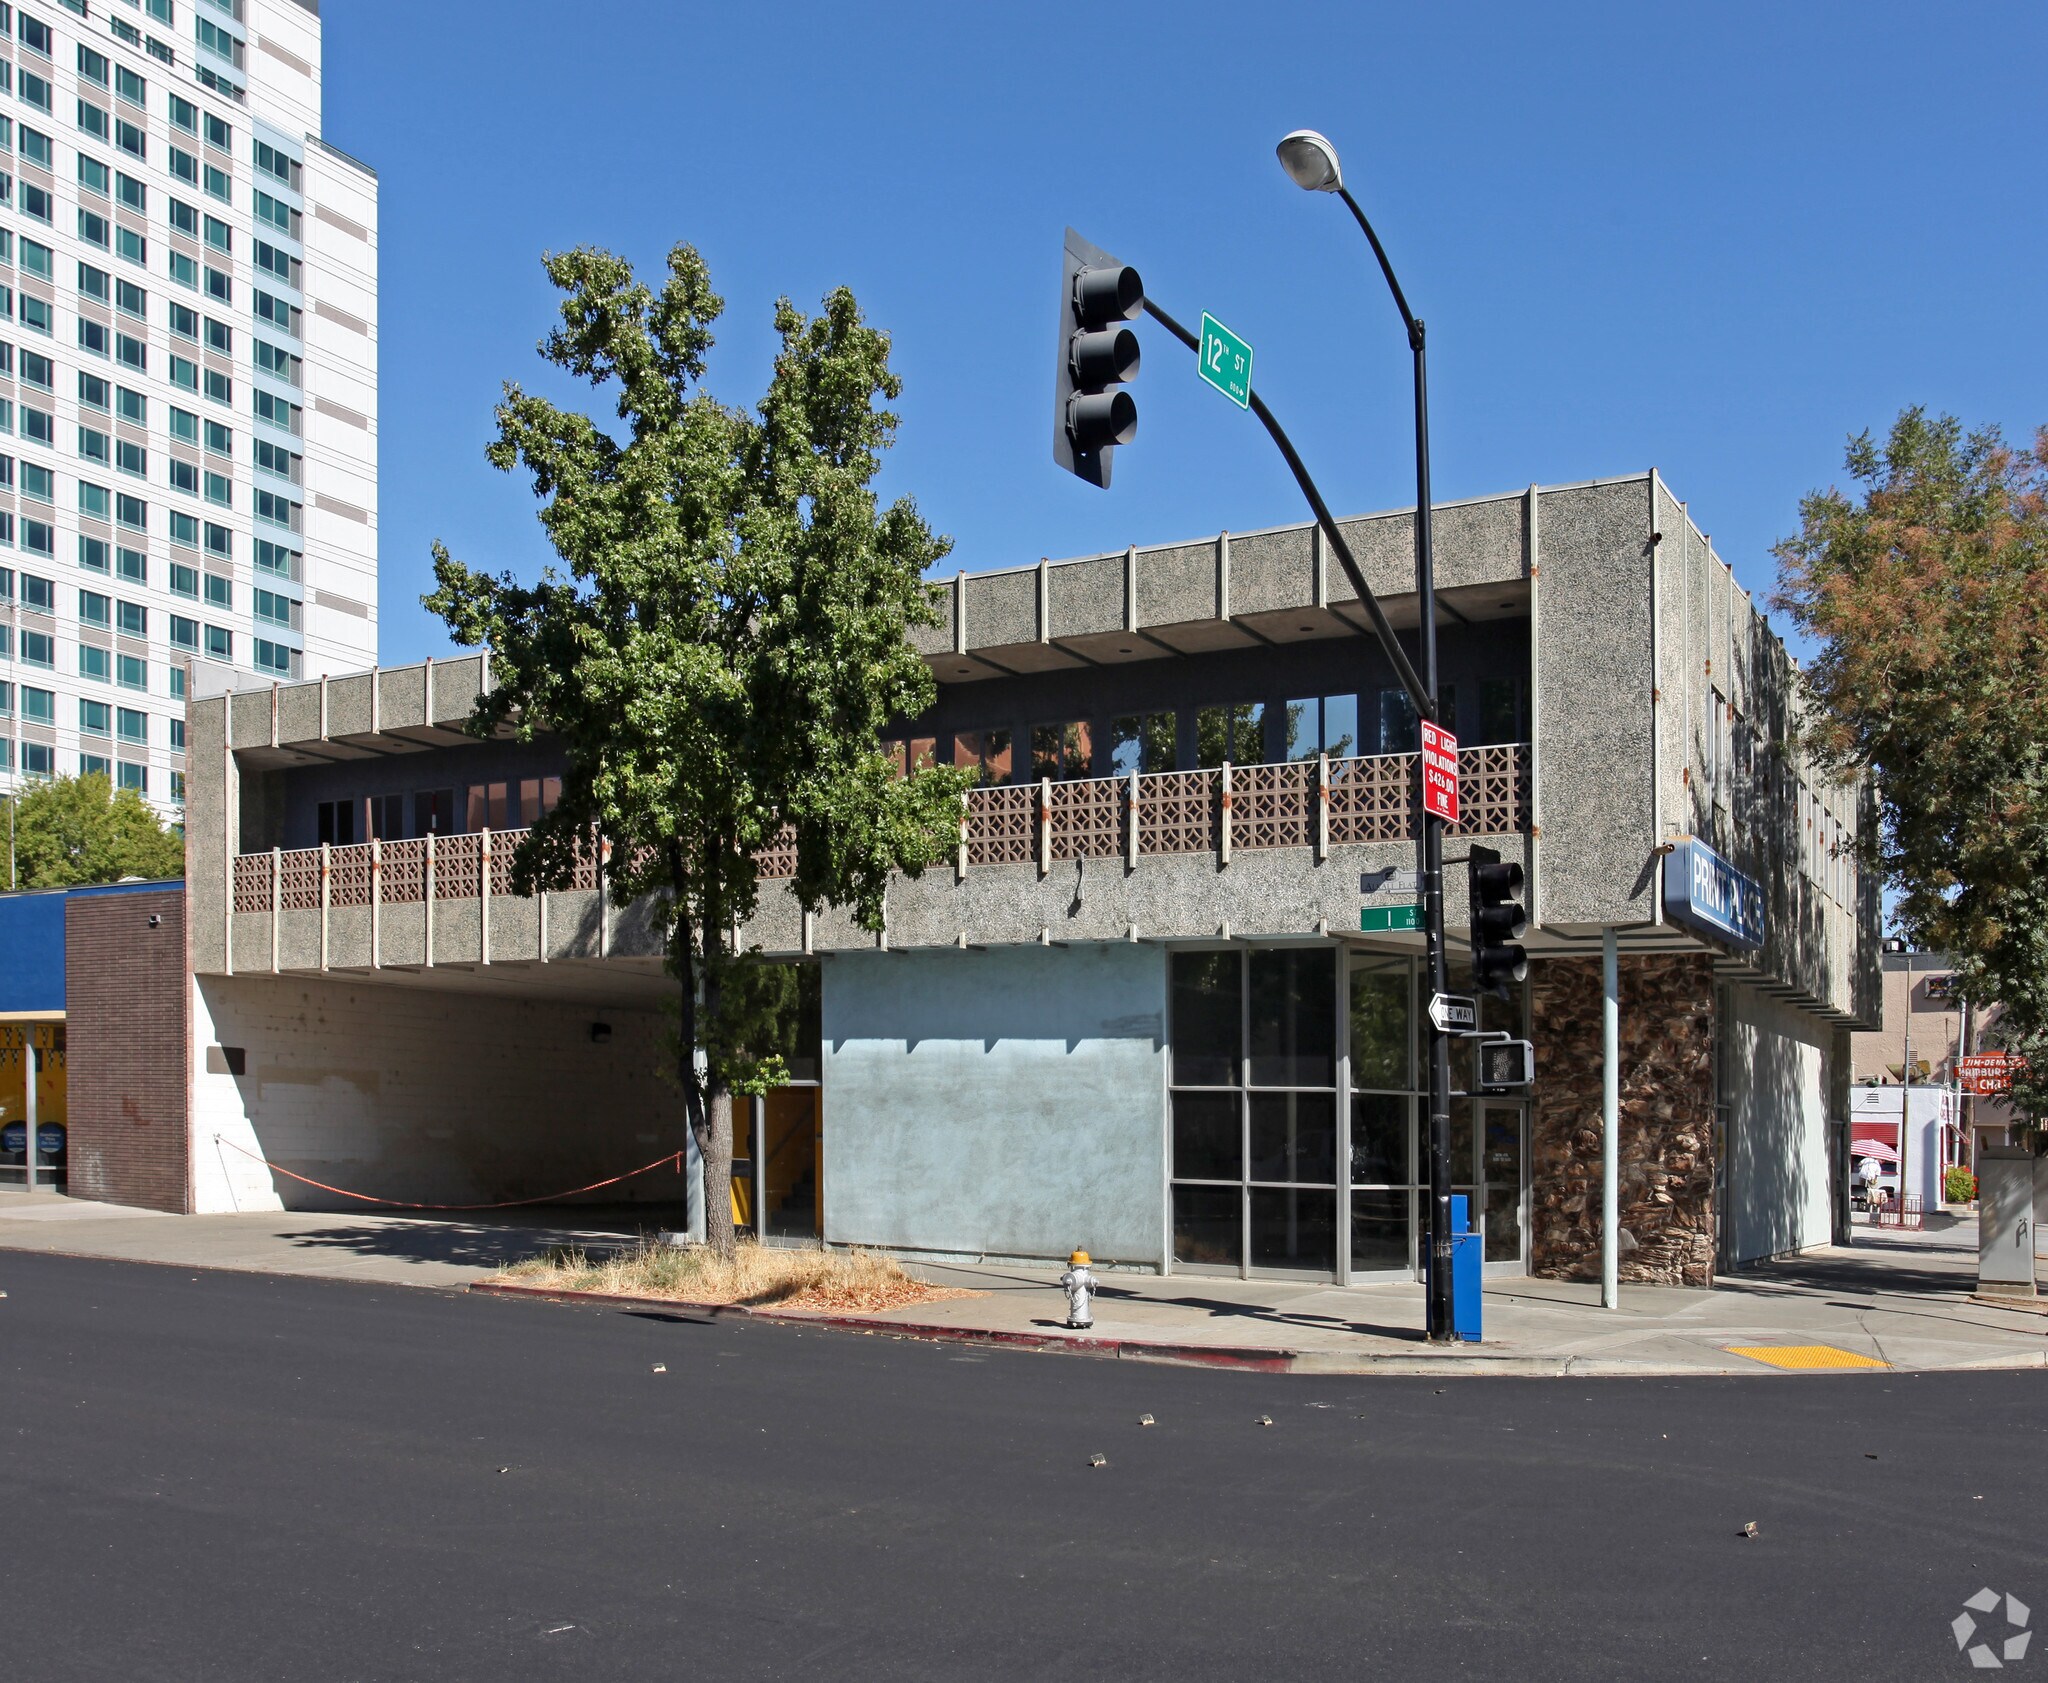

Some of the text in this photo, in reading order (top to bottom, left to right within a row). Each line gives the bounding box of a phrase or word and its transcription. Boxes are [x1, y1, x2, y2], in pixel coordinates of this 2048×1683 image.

[1234, 353, 1245, 374] ST
[1423, 727, 1456, 756] RED LIGHT
[1424, 748, 1457, 776] VIOLATIONS
[1428, 769, 1454, 794] $426.00
[1437, 791, 1448, 809] FINE
[1693, 852, 1762, 936] PRINT PLACE
[1441, 1006, 1472, 1021] ONE WAY
